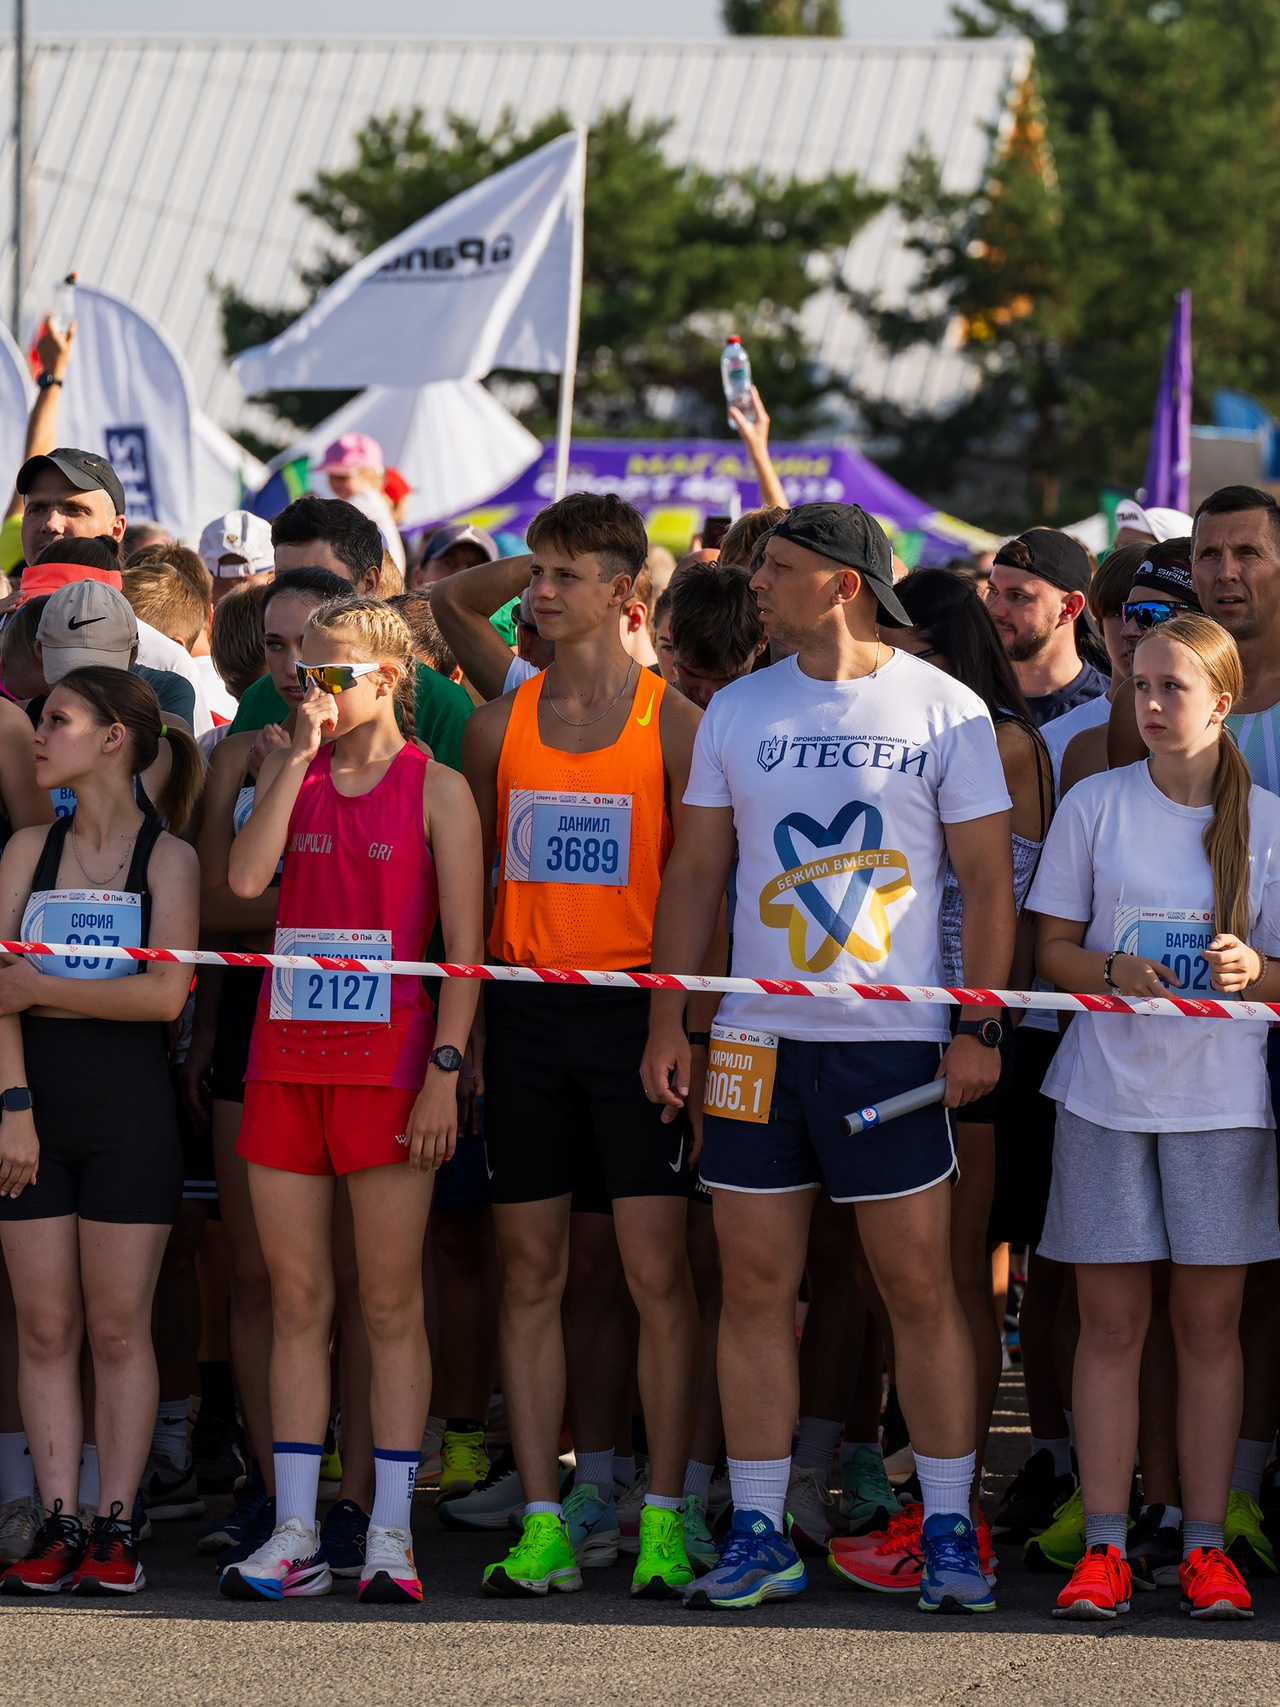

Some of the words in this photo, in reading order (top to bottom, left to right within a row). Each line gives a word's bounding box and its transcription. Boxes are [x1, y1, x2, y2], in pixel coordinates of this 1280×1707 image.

[793, 734, 867, 743] ПРОИЗВОДСТВЕННАЯ
[868, 735, 908, 744] КОМПАНИЯ
[789, 740, 930, 778] ТЕСЕЙ
[60, 787, 78, 800] ВА
[602, 797, 614, 805] Пэй
[558, 815, 610, 833] ДАНИИЛ
[546, 836, 619, 874] 3689
[776, 860, 830, 891] БЕЖИМ
[834, 852, 890, 871] ВМЕСТЕ
[111, 894, 123, 902] Пэй
[71, 912, 114, 930] СОФИЯ
[360, 933, 372, 941] Пэй
[308, 974, 380, 1010] 2127
[748, 1035, 760, 1043] Пэй
[710, 1049, 753, 1071] КИРИЛЛ
